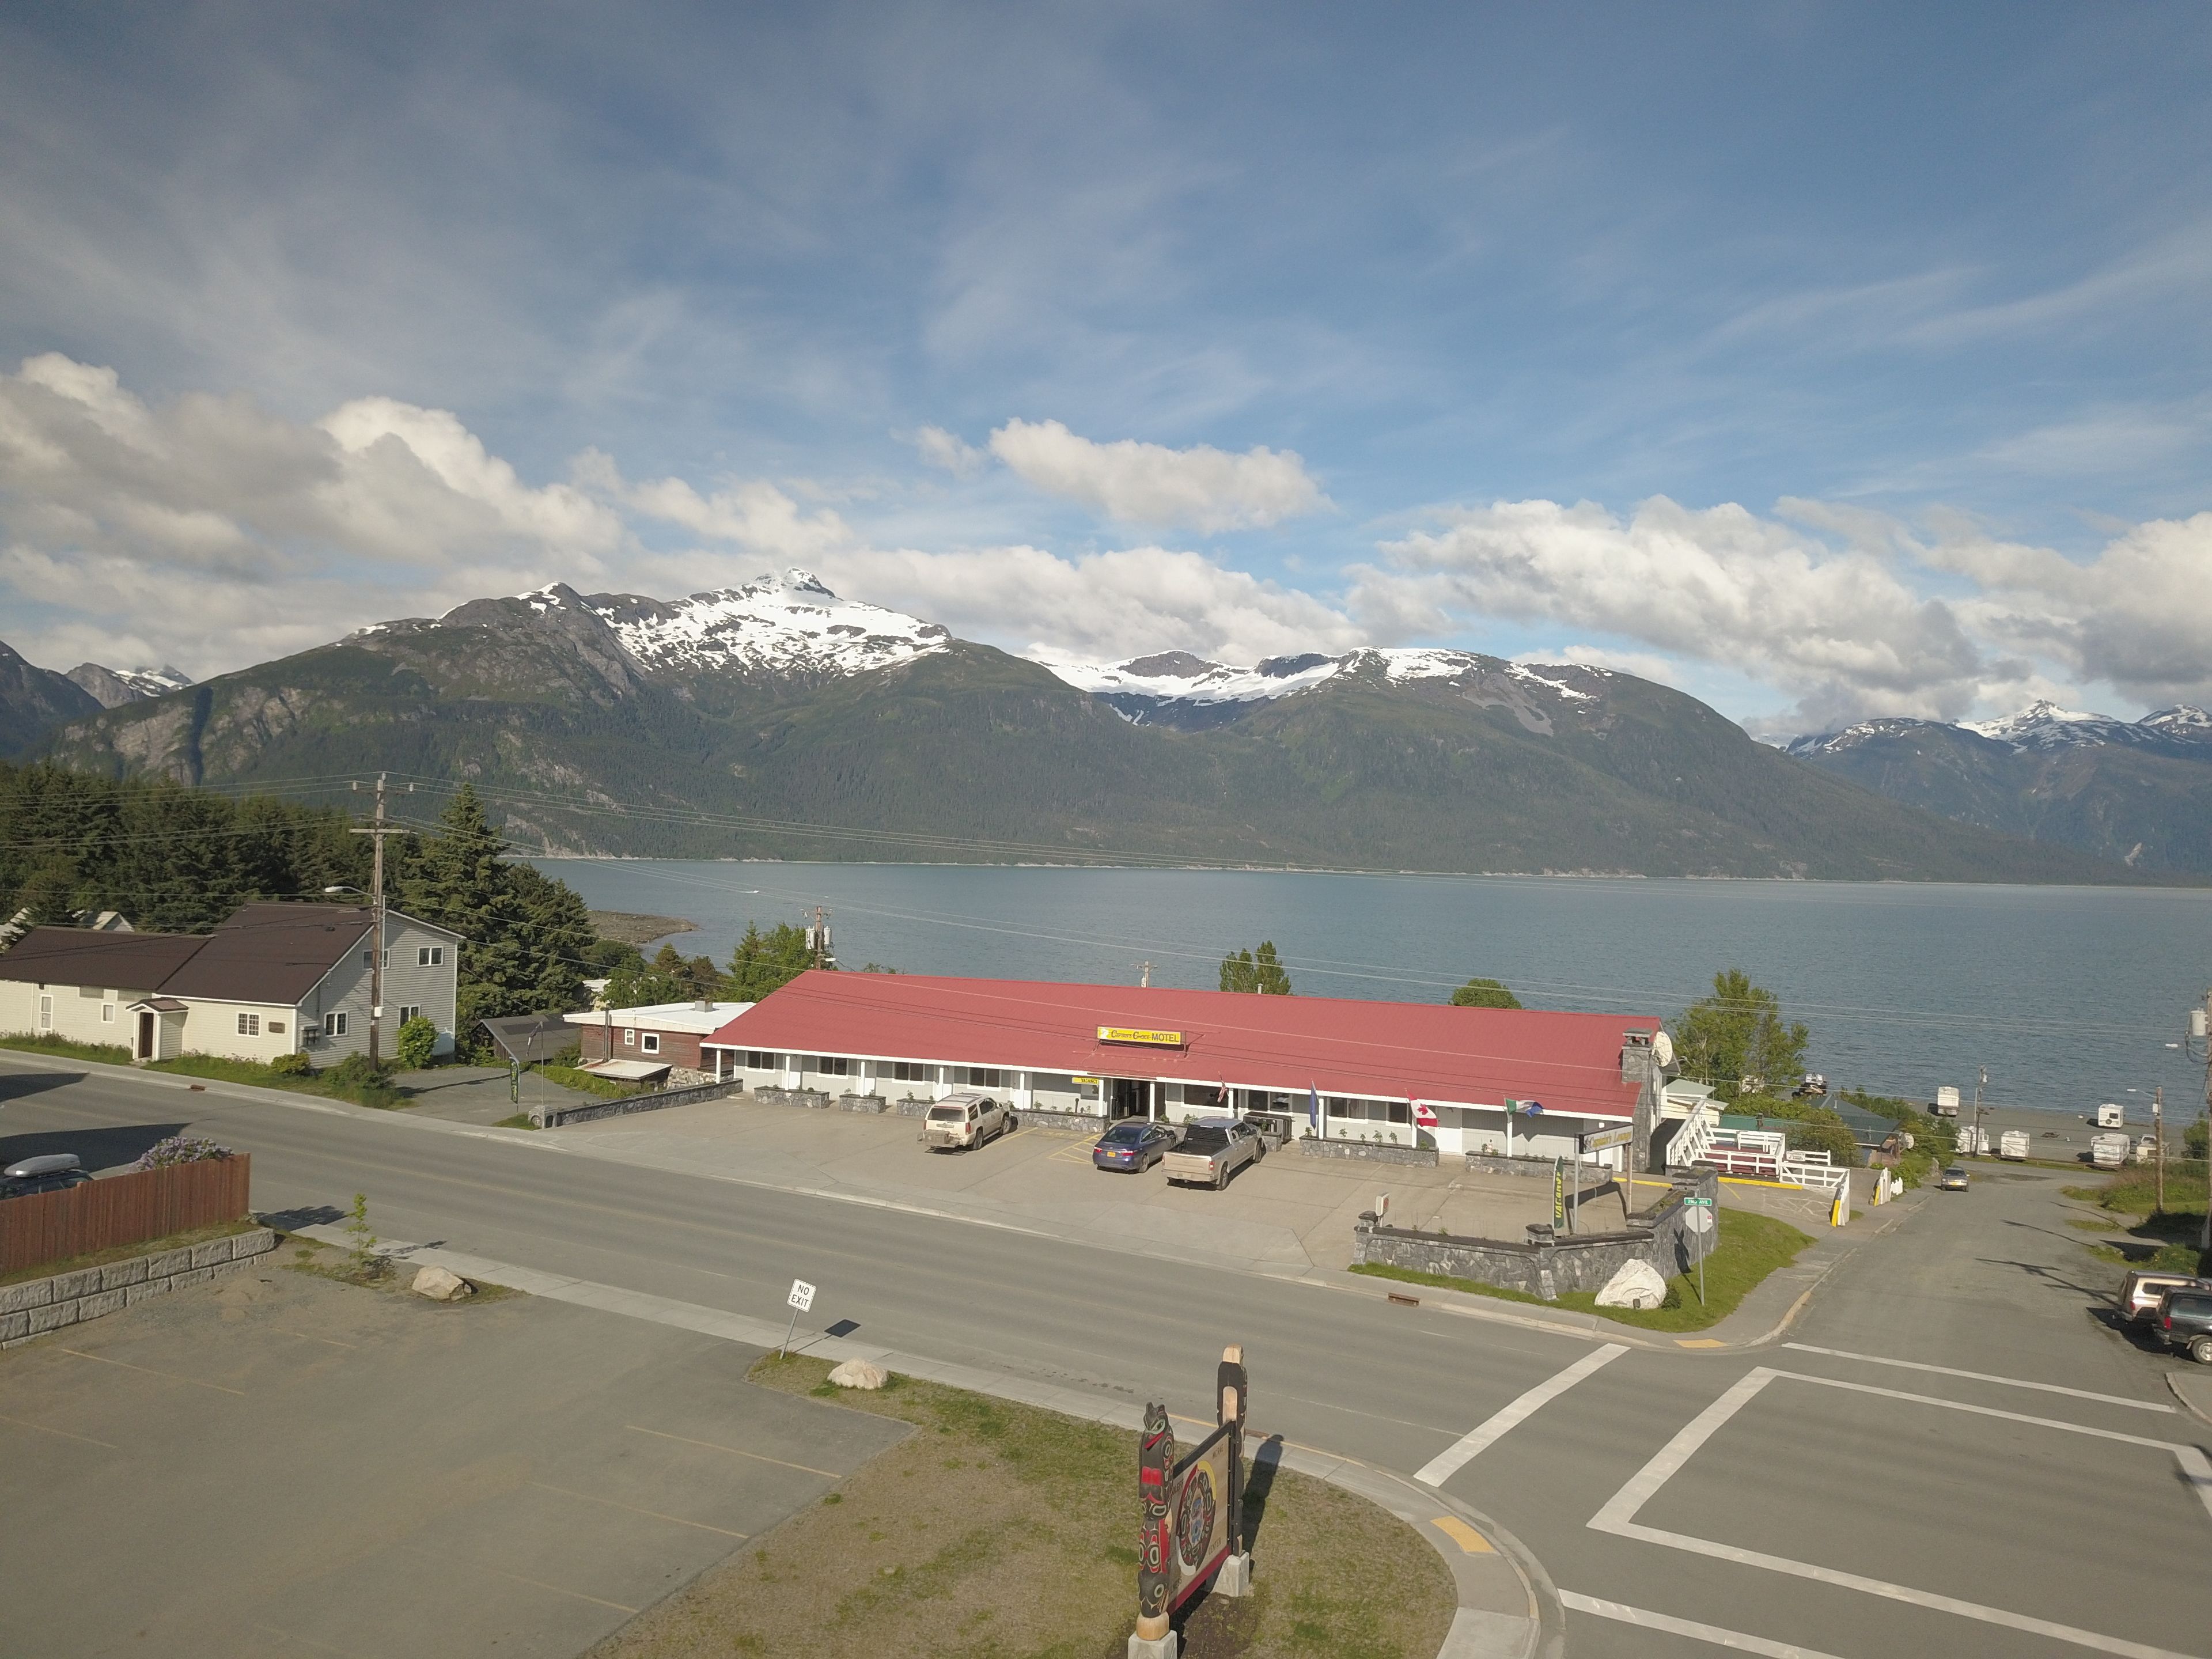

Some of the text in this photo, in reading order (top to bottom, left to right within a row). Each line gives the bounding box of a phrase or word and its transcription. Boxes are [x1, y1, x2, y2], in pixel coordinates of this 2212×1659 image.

[1152, 1033, 1179, 1042] MOTEL
[797, 1285, 809, 1296] NO
[791, 1294, 809, 1307] EXIT
[1208, 1537, 1221, 1555] CENTER
